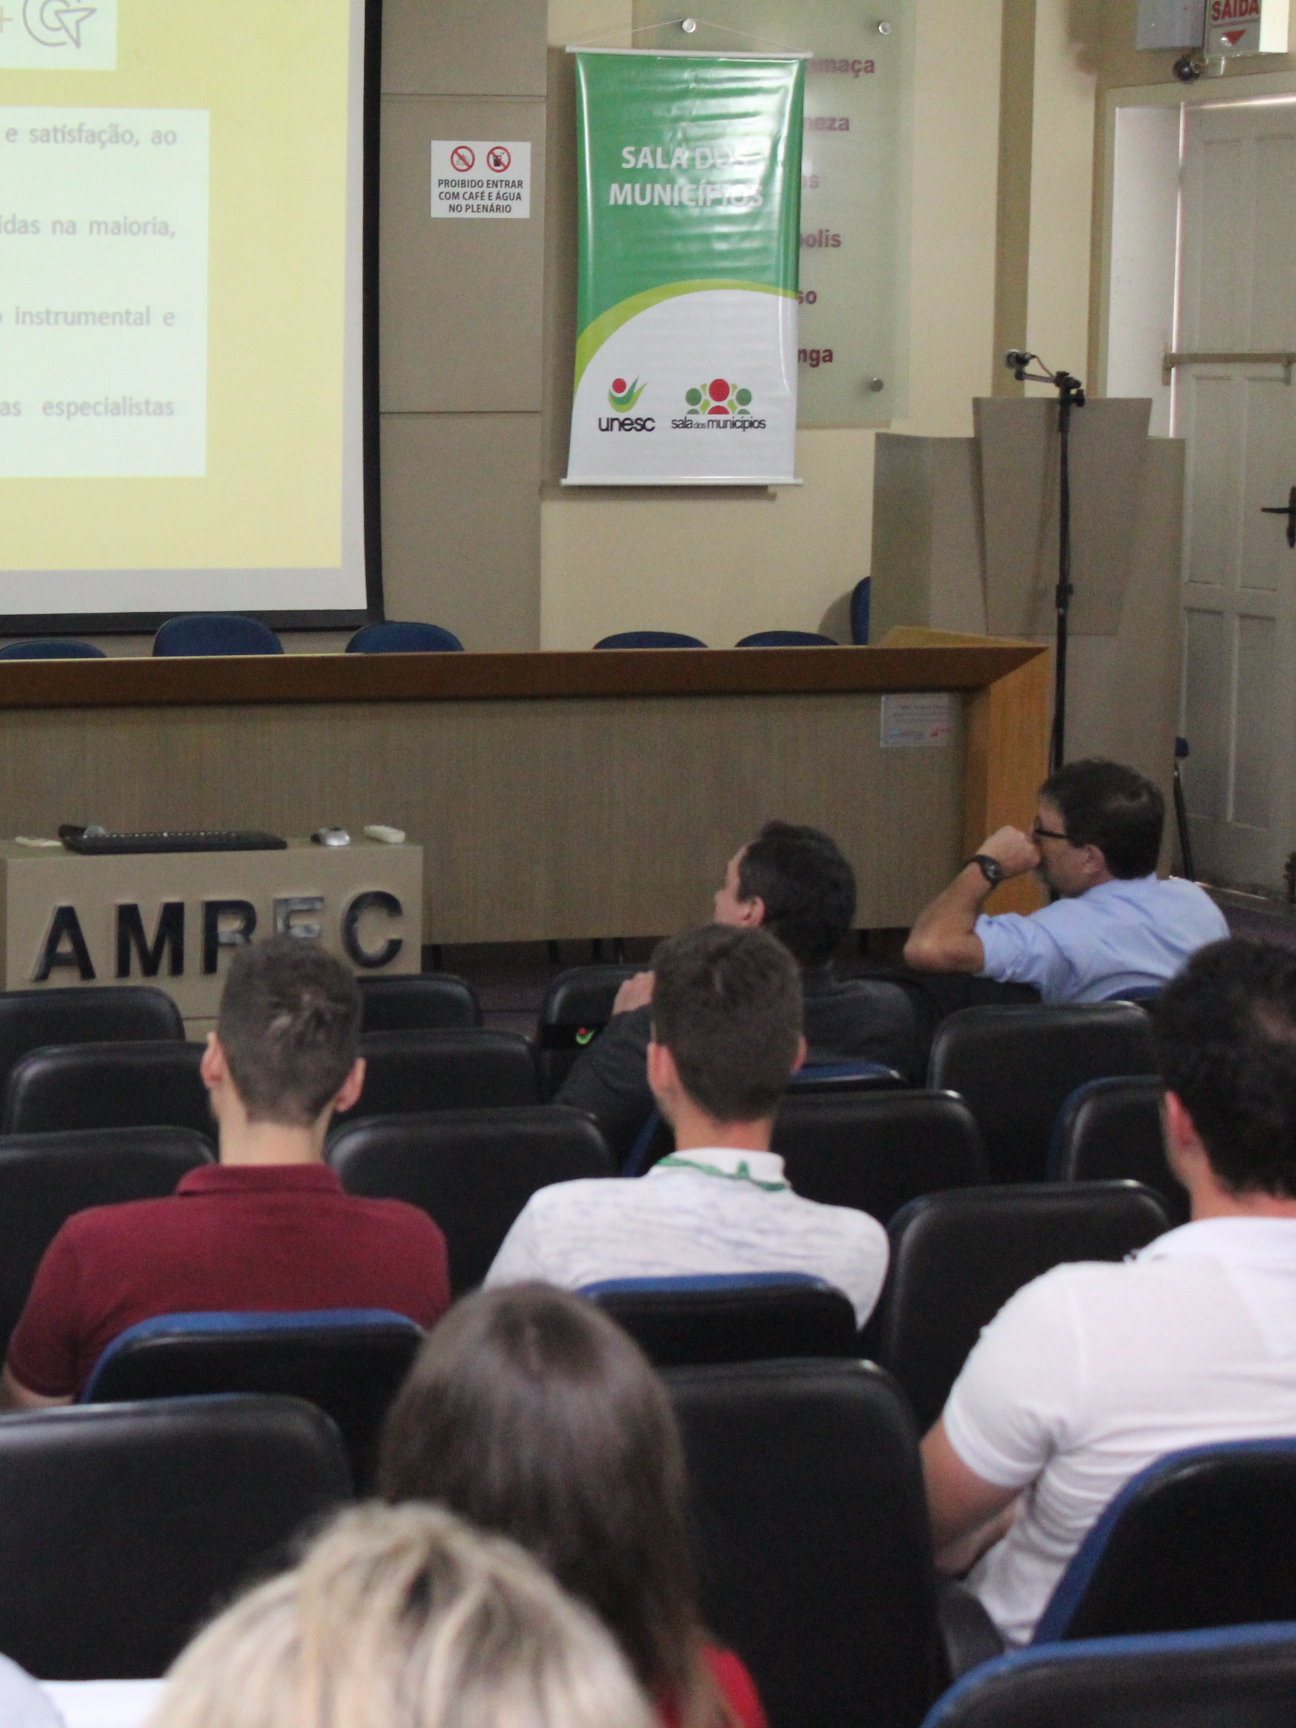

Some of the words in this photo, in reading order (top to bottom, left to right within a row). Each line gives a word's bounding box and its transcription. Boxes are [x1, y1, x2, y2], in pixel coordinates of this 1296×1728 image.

[4, 126, 19, 144] e
[28, 121, 140, 150] satisfação,
[150, 129, 178, 146] ao
[621, 145, 689, 170] SALA
[437, 178, 484, 189] PROIBIDO
[486, 179, 524, 189] ENTRAR
[438, 191, 460, 201] COM
[462, 189, 486, 201] CAFÉ
[487, 191, 494, 201] E
[495, 190, 522, 201] ÁGUA
[608, 179, 764, 208] MUNICÍPIOS
[448, 203, 463, 213] NO
[464, 202, 512, 213] PLENÁRIO
[50, 219, 78, 236] na
[88, 215, 176, 239] maioria,
[14, 304, 151, 327] instrumental
[162, 311, 176, 327] e
[41, 394, 175, 421] especialistas
[598, 416, 656, 432] unesc
[670, 416, 693, 430] sala
[707, 416, 767, 432] municípios
